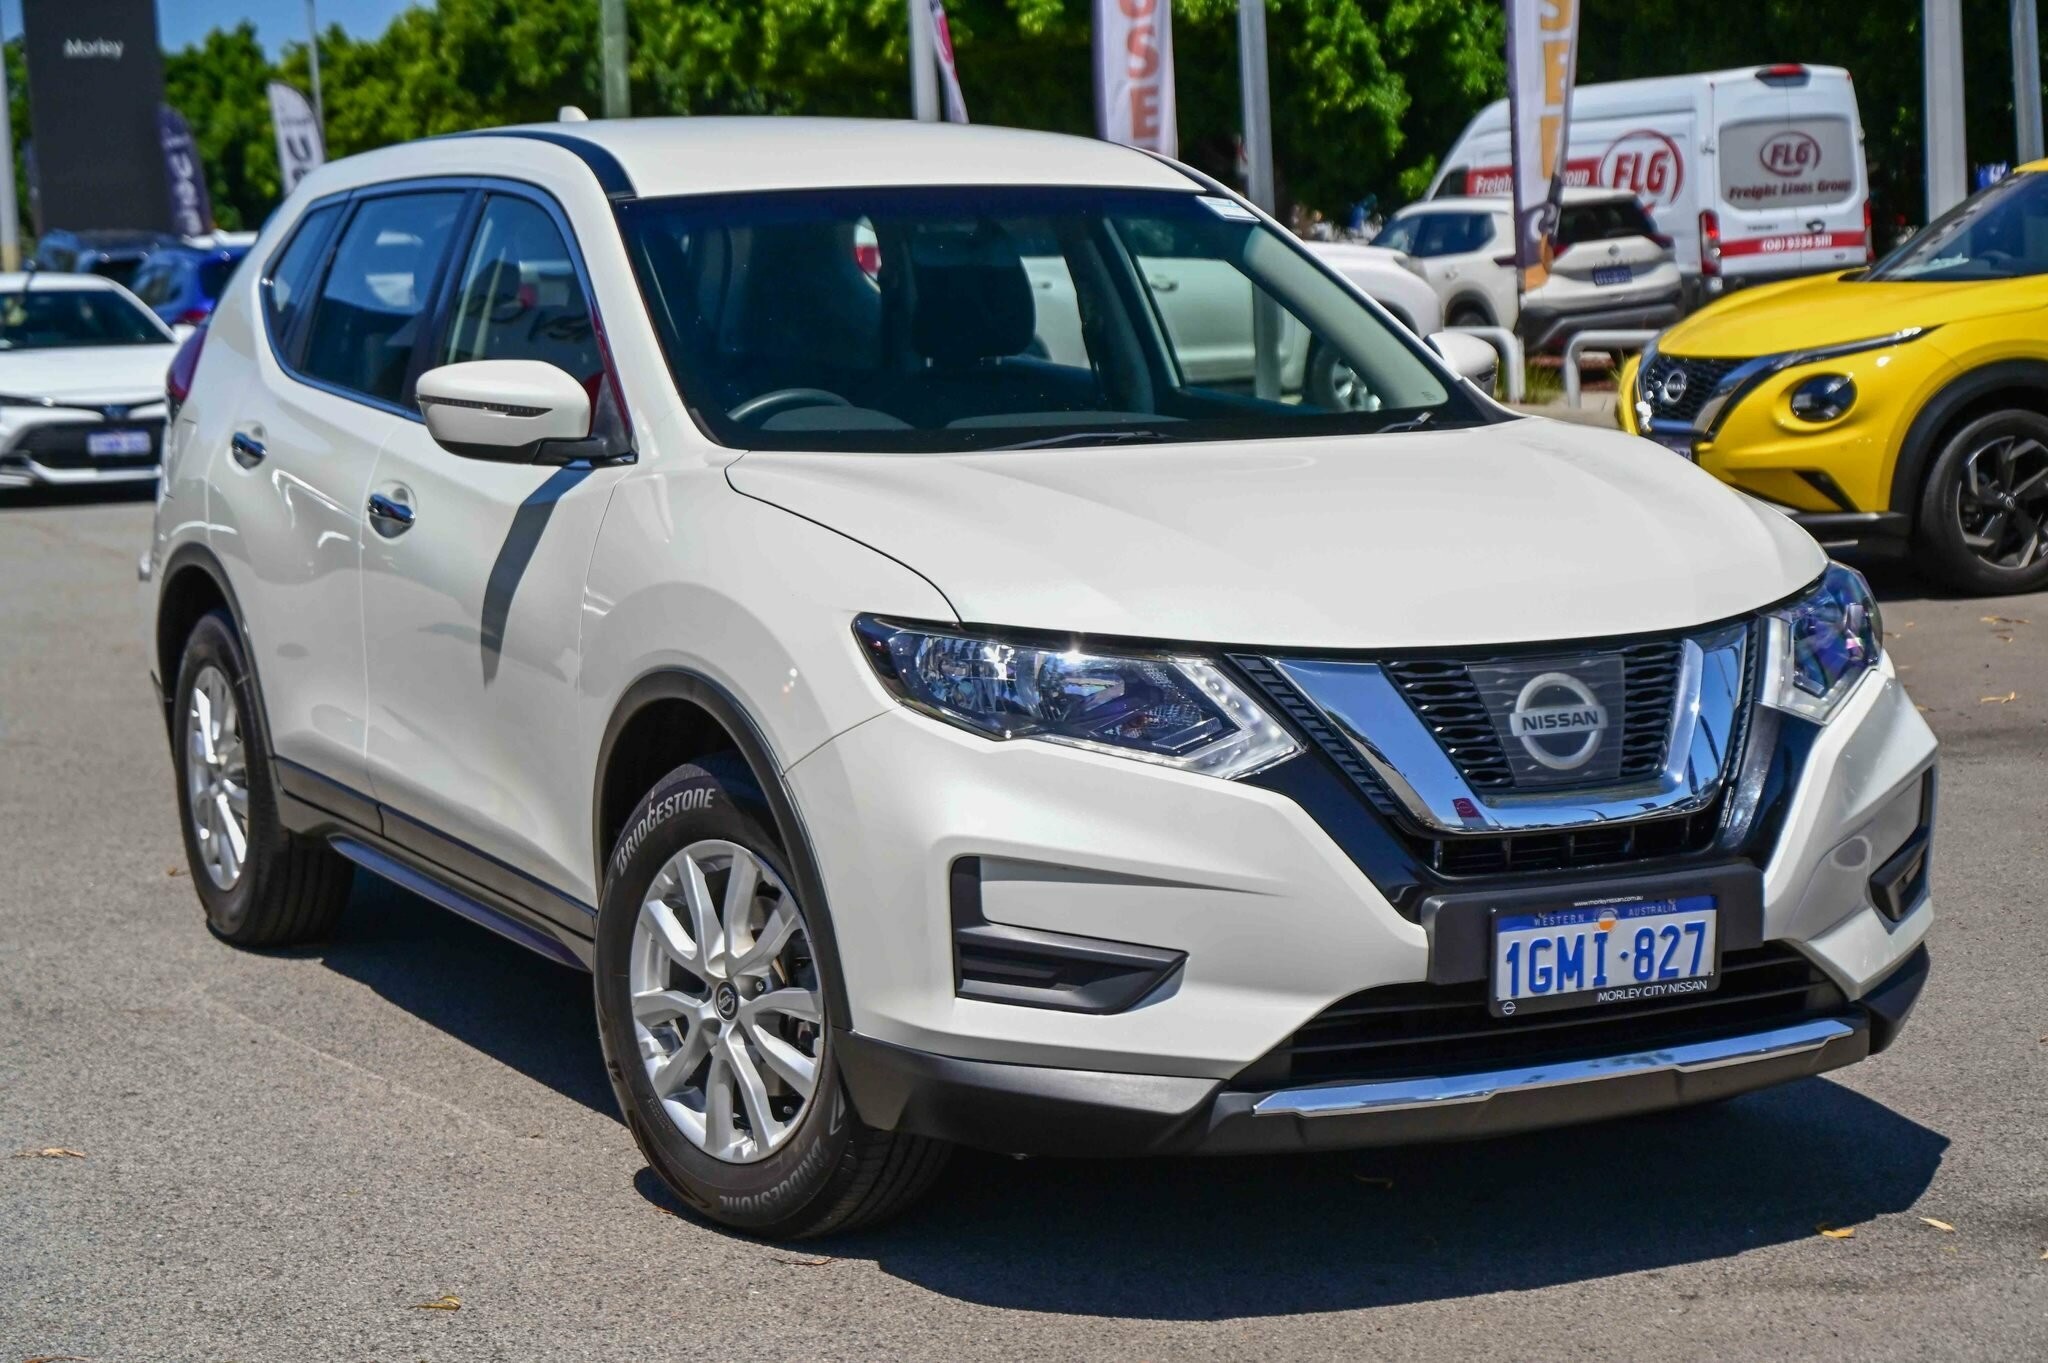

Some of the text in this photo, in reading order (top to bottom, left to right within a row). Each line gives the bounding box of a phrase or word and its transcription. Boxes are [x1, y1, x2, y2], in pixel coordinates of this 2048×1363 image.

[1770, 142, 1811, 167] FLG
[1612, 150, 1671, 196] FLG
[1729, 179, 1851, 199] Freight Lines Group
[1521, 711, 1599, 731] NISSAN
[616, 788, 716, 877] BRIDGESTONE
[1534, 903, 1677, 926] WESTERN AUSTRALIA
[1598, 980, 1707, 1003] MORLEY CITY NISSAN
